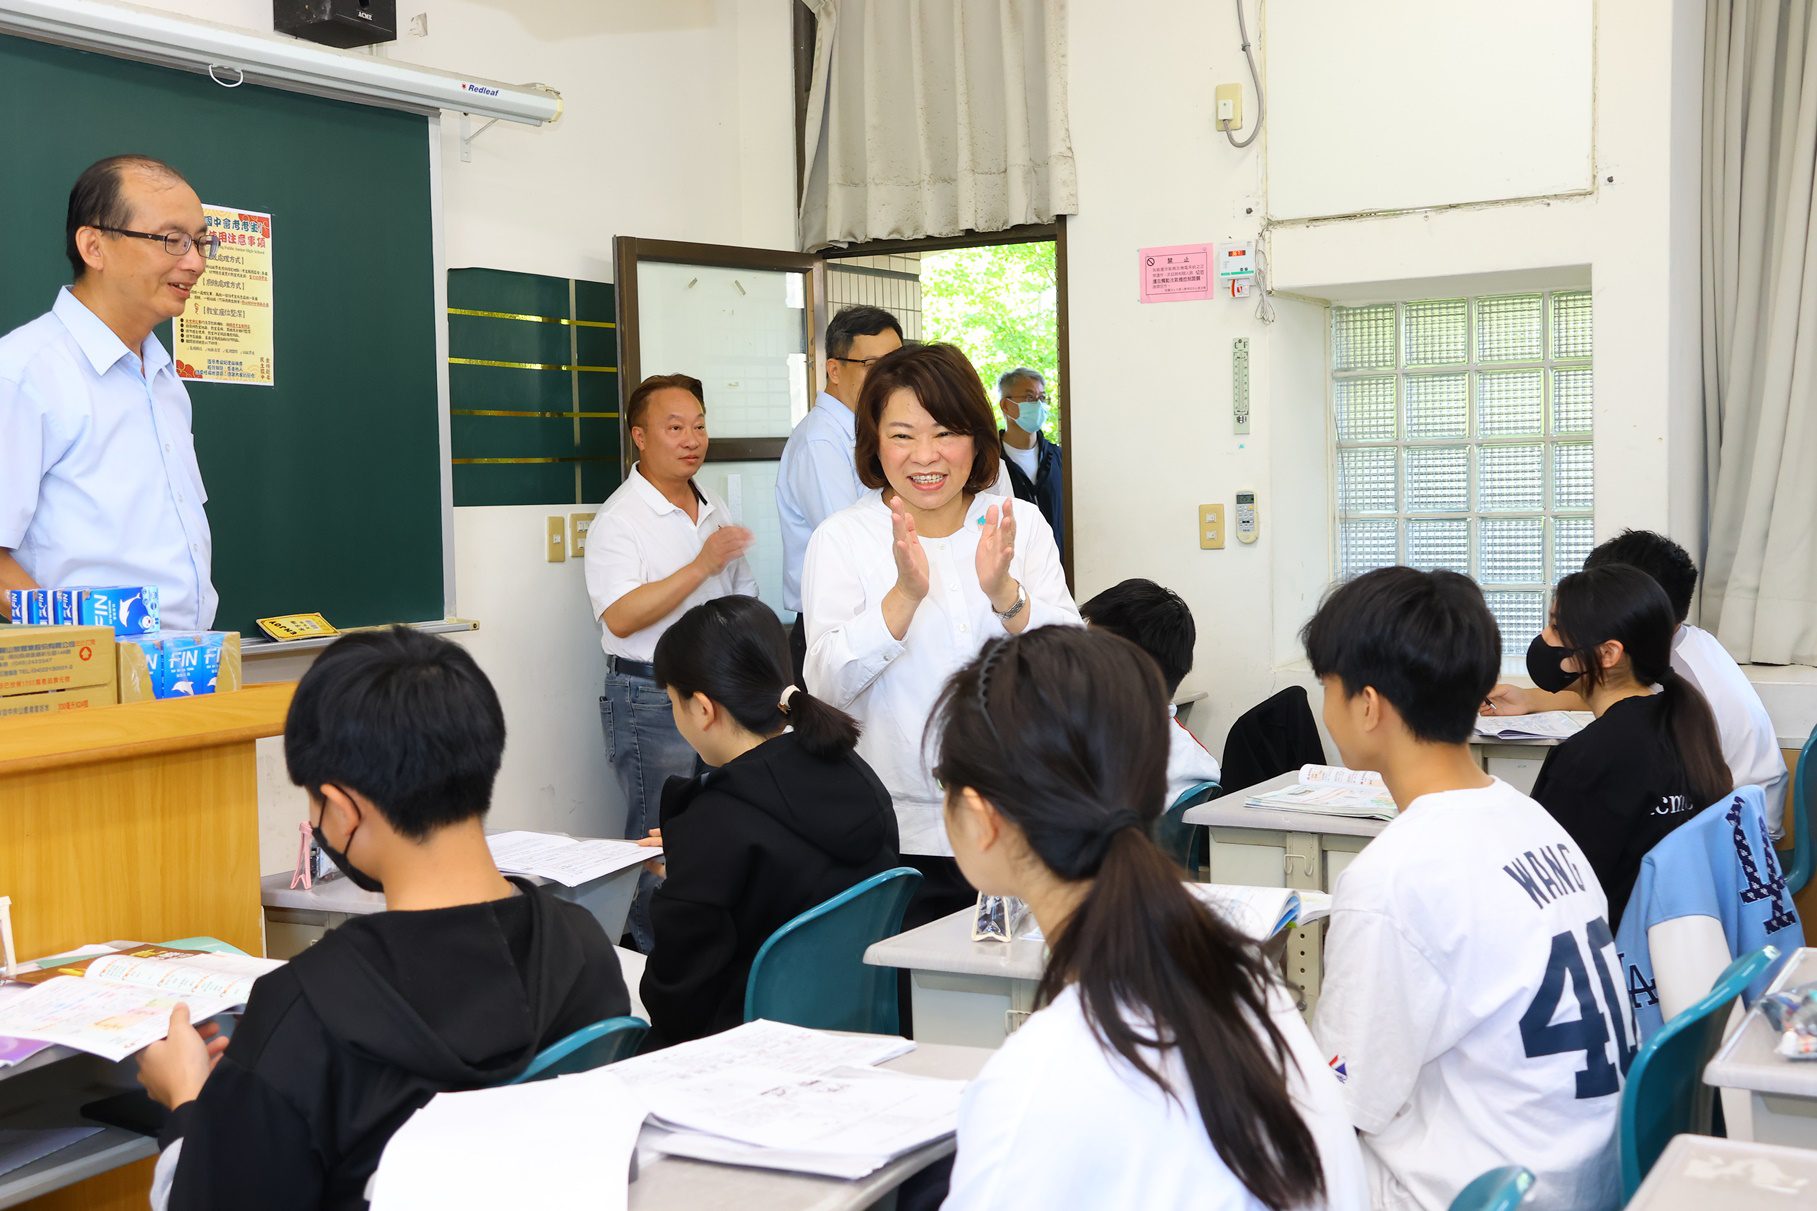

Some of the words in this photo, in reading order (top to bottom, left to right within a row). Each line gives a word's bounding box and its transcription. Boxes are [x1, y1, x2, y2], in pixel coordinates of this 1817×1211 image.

[468, 84, 499, 97] Redleaf
[169, 649, 198, 668] FIN
[204, 648, 220, 665] FI
[1502, 843, 1586, 909] WANG
[1519, 915, 1640, 1099] 40
